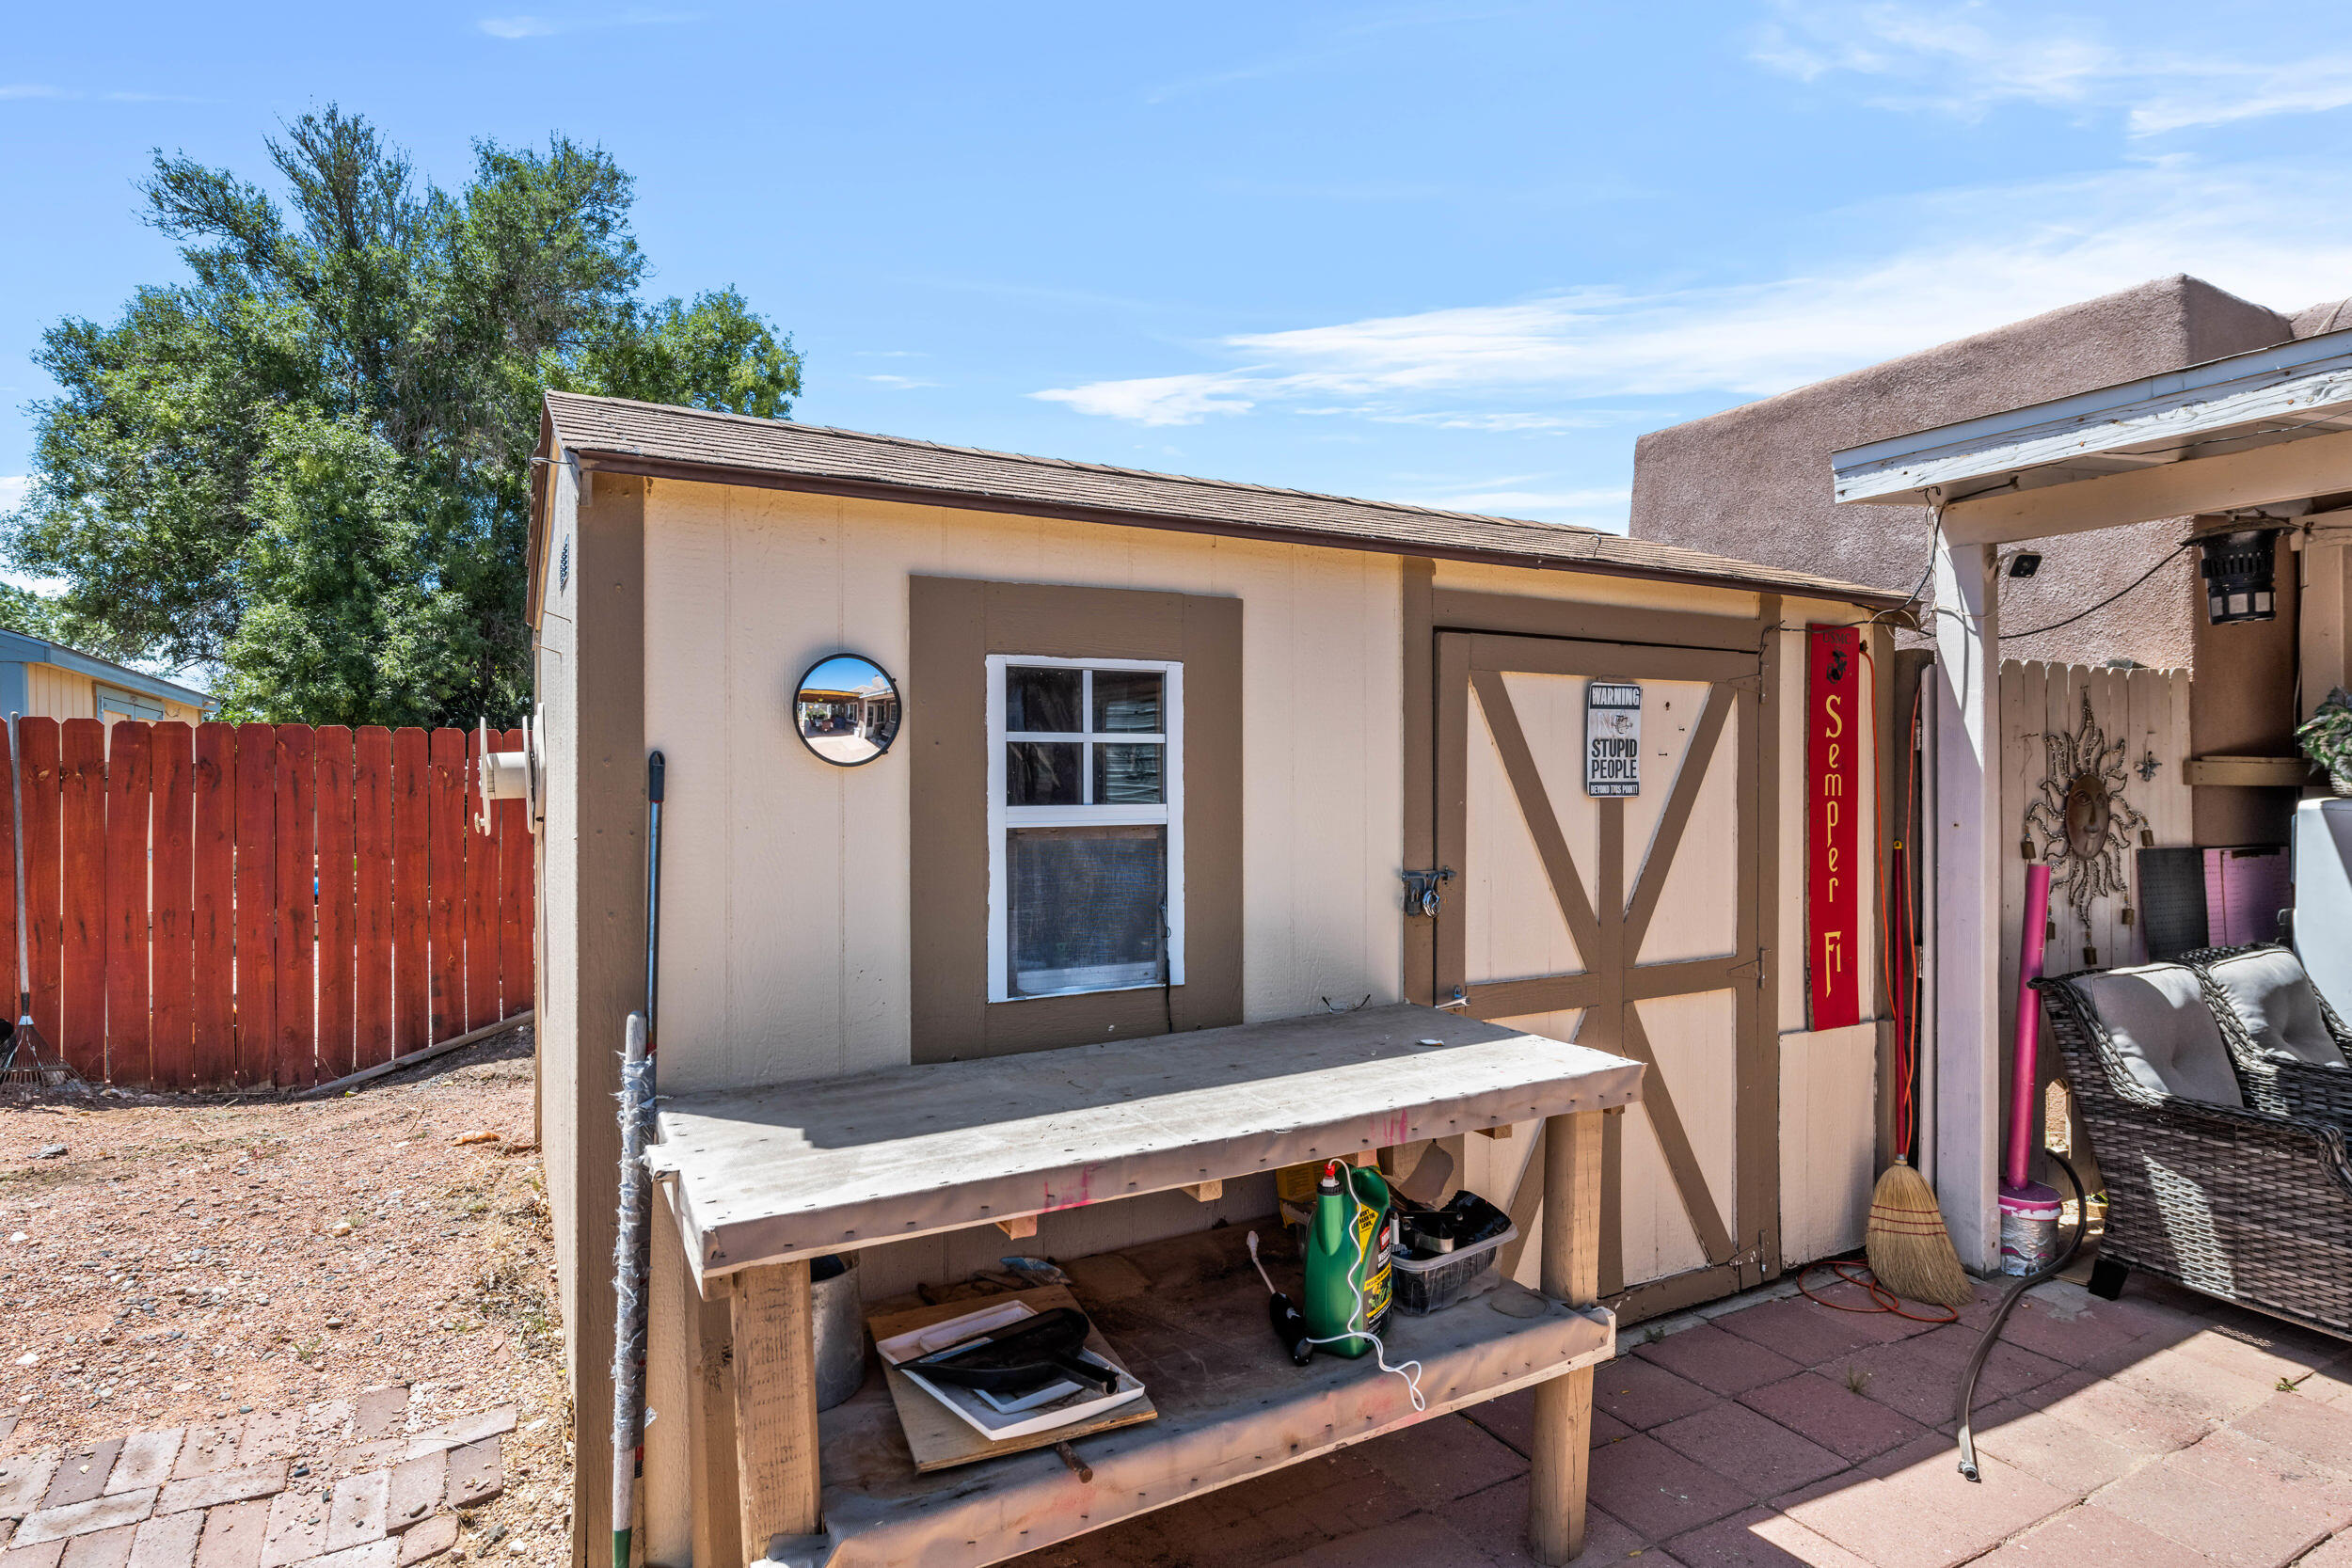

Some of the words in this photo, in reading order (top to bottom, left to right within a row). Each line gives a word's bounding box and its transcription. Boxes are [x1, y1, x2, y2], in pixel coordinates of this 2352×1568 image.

[1822, 631, 1851, 645] USMC
[1592, 687, 1640, 705] WARNING
[1591, 738, 1638, 758] STUPID
[1591, 759, 1637, 779] PEOPLE
[1590, 784, 1610, 795] BEYOND
[1611, 784, 1622, 794] THIS
[1824, 694, 1843, 903] Semper
